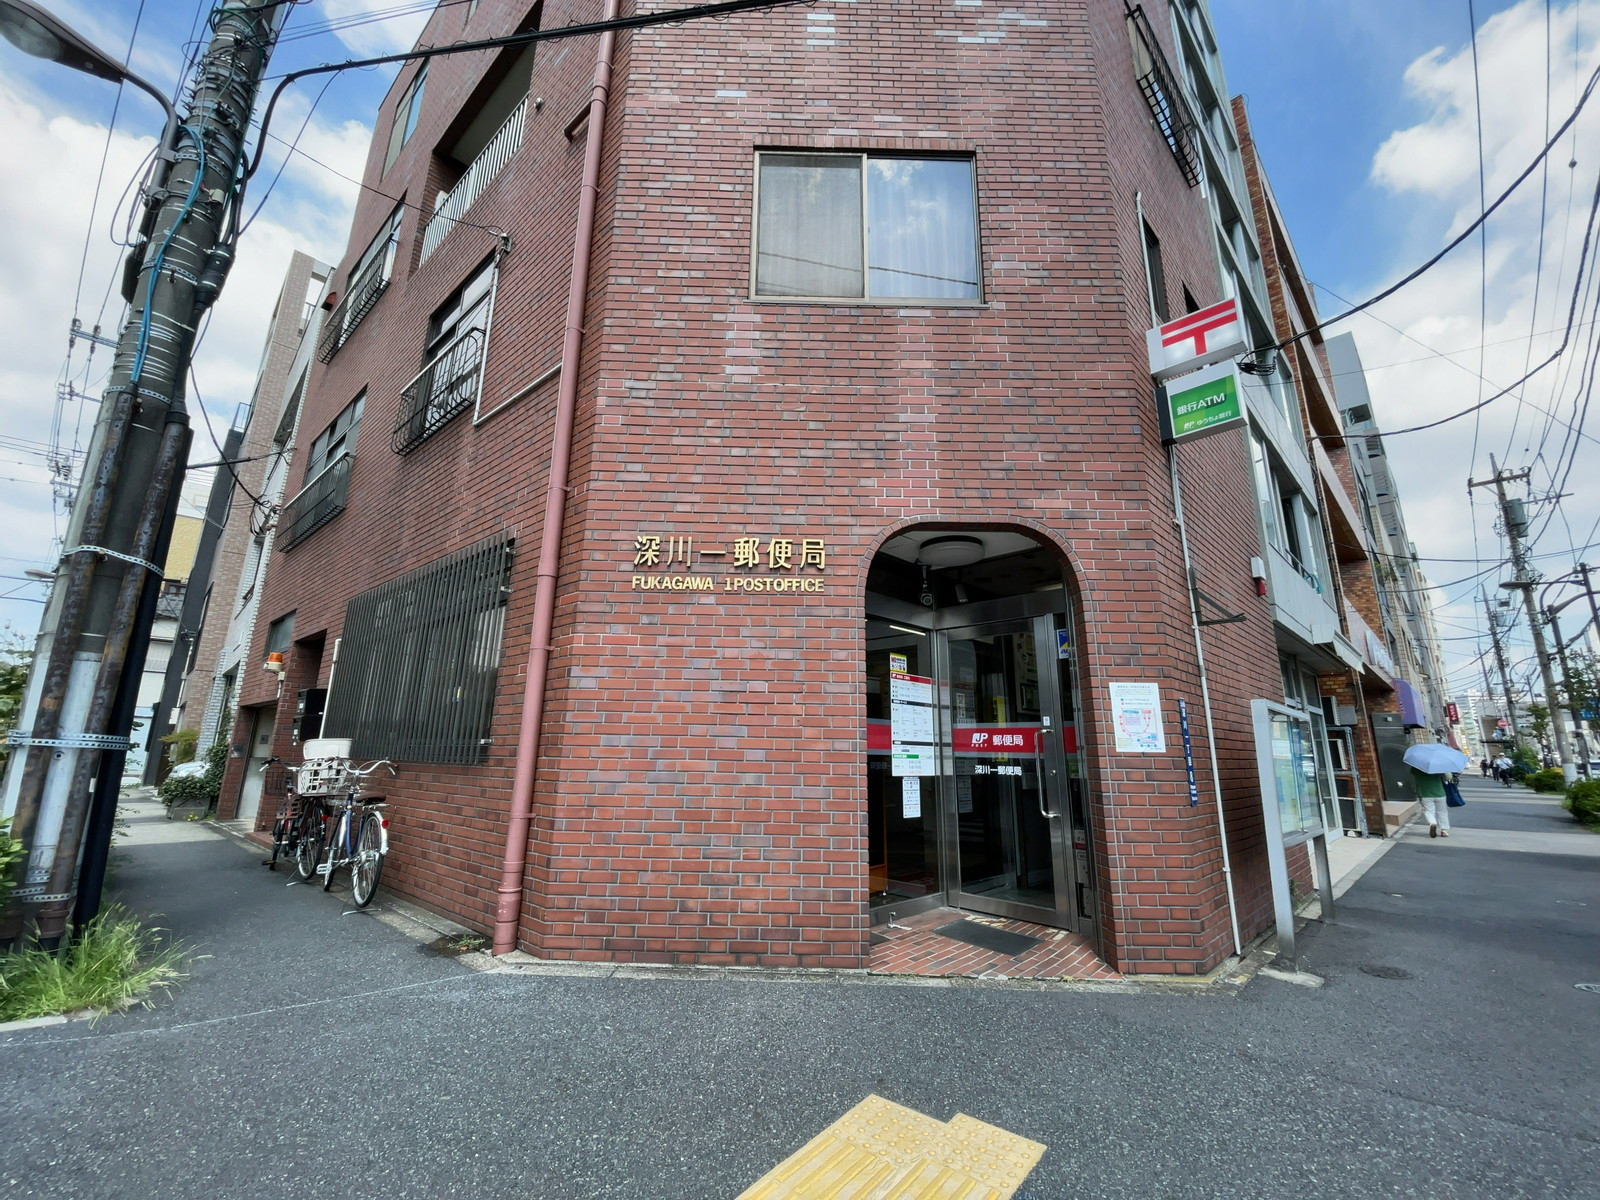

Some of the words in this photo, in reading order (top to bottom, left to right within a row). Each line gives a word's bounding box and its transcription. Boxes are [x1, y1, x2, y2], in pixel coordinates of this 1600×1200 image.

[1177, 392, 1226, 415] 銀行ATM
[1197, 410, 1232, 425] ゆうちょ銀行
[633, 535, 826, 569] 深川一郵便局
[632, 575, 714, 590] FUKAGAWA
[992, 734, 1023, 746] 郵便局
[974, 764, 1022, 776] 深川一郵便局
